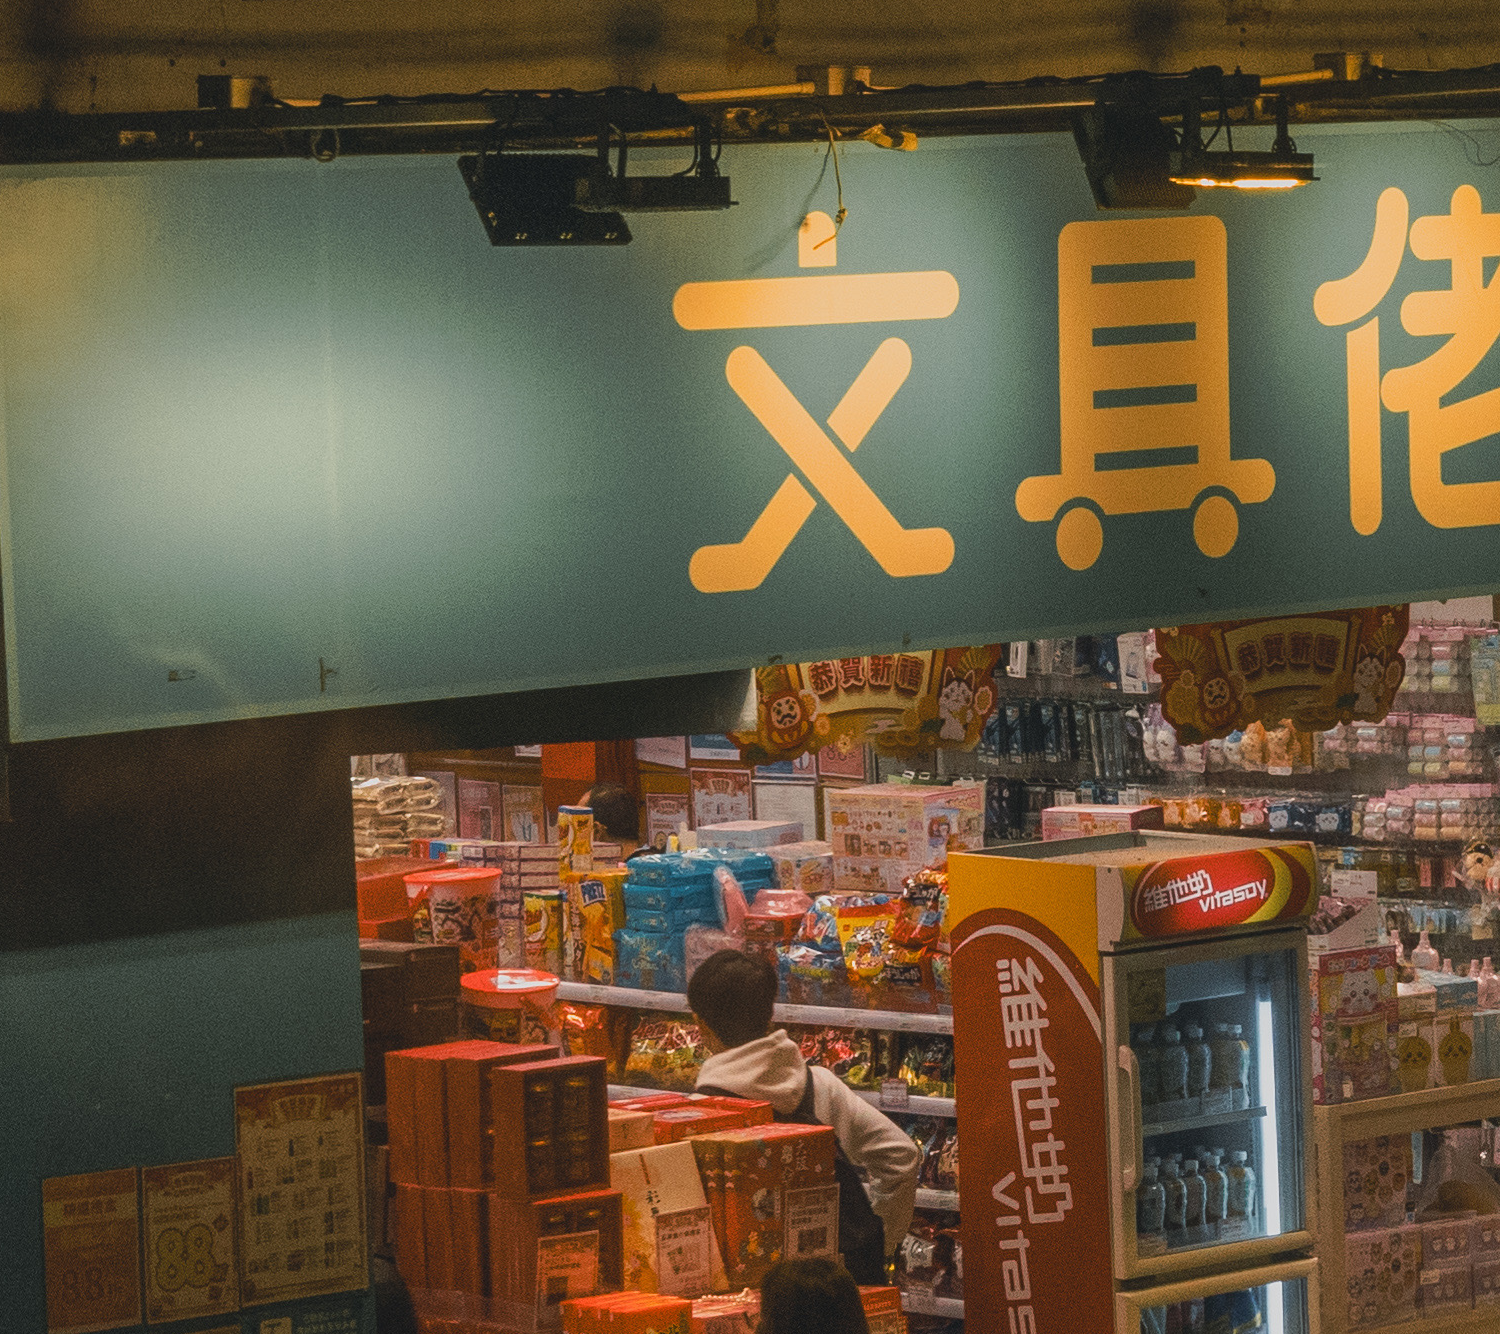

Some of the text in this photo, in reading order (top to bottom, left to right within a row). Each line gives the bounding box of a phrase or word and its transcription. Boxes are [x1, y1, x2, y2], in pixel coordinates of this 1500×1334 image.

[809, 652, 924, 695] 恭賀新禧
[1237, 632, 1339, 677] 恭賀新禧
[1144, 870, 1211, 912] 維他奶
[997, 955, 1073, 1224] 維他奶
[156, 1223, 215, 1292] 88
